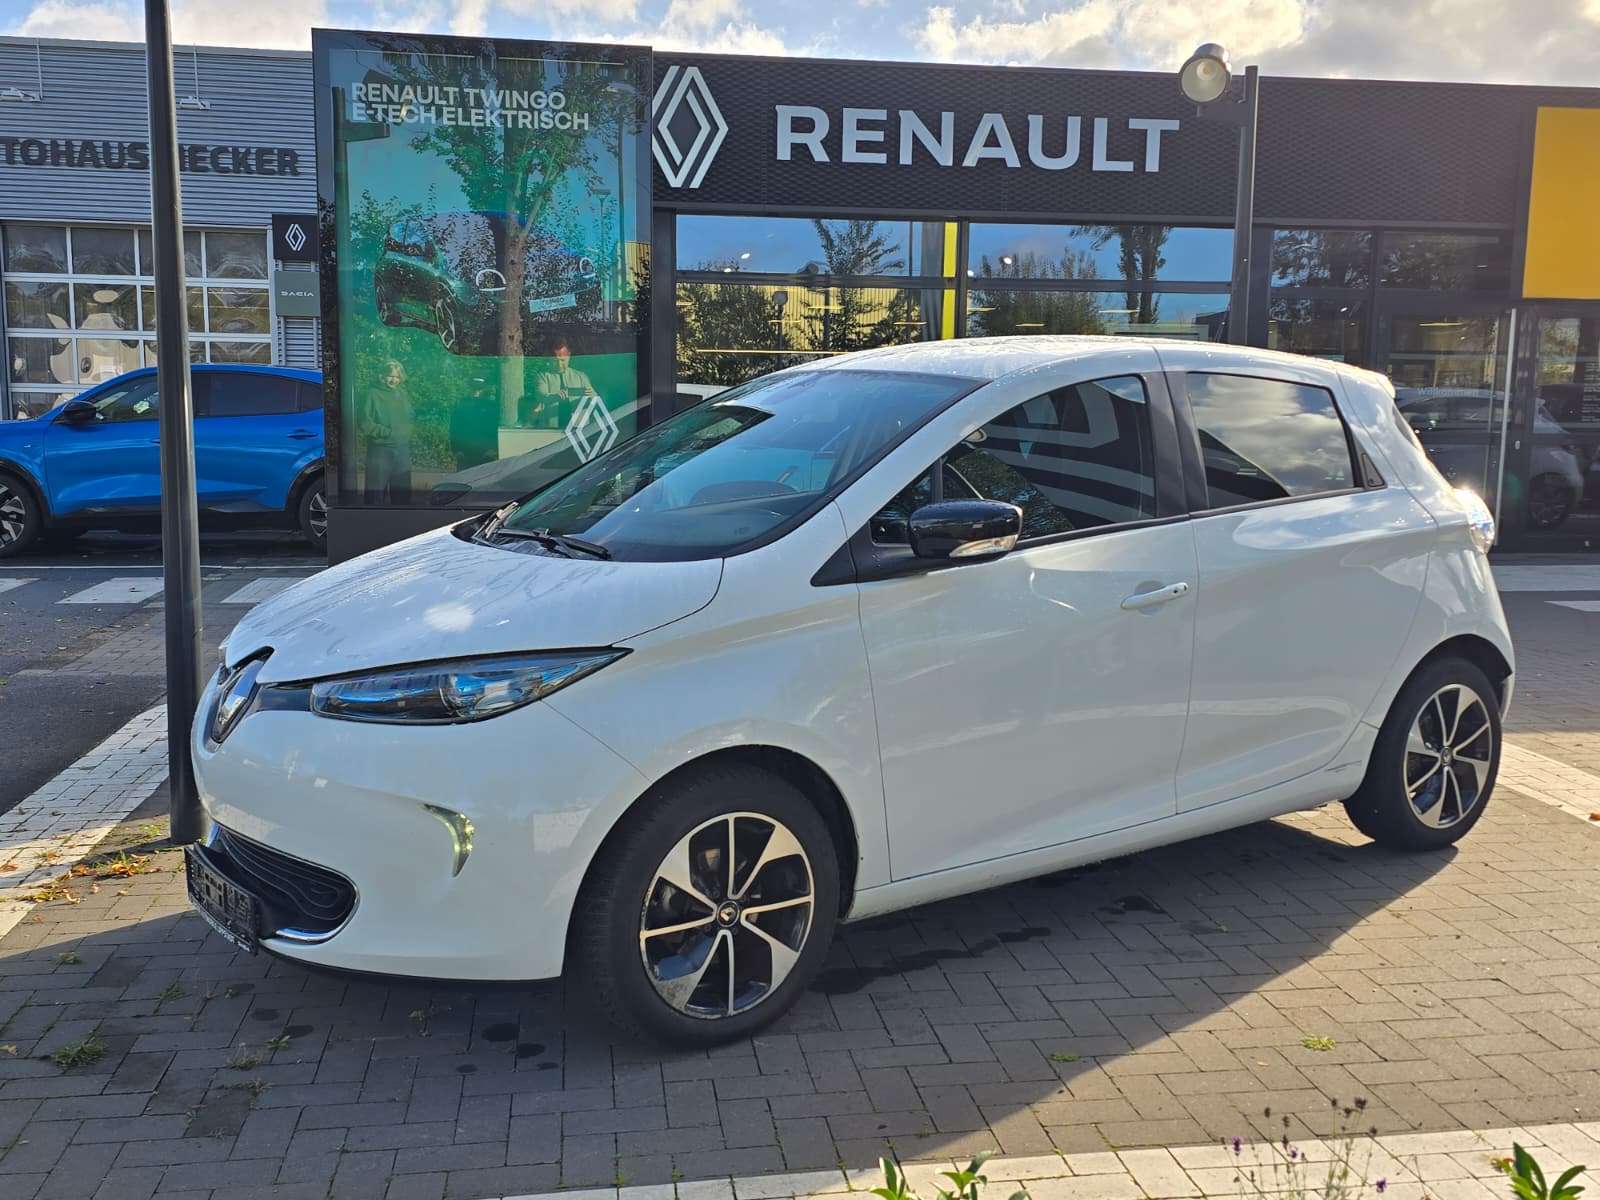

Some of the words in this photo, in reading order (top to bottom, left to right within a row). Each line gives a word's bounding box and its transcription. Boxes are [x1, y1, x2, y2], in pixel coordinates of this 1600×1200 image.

[351, 82, 460, 106] RENAULT
[463, 88, 566, 110] TWINGO
[351, 102, 436, 124] E-TECH
[443, 107, 590, 131] ELEKTRISCH
[0, 136, 149, 170] TOHAUS
[774, 104, 1181, 173] RENAULT
